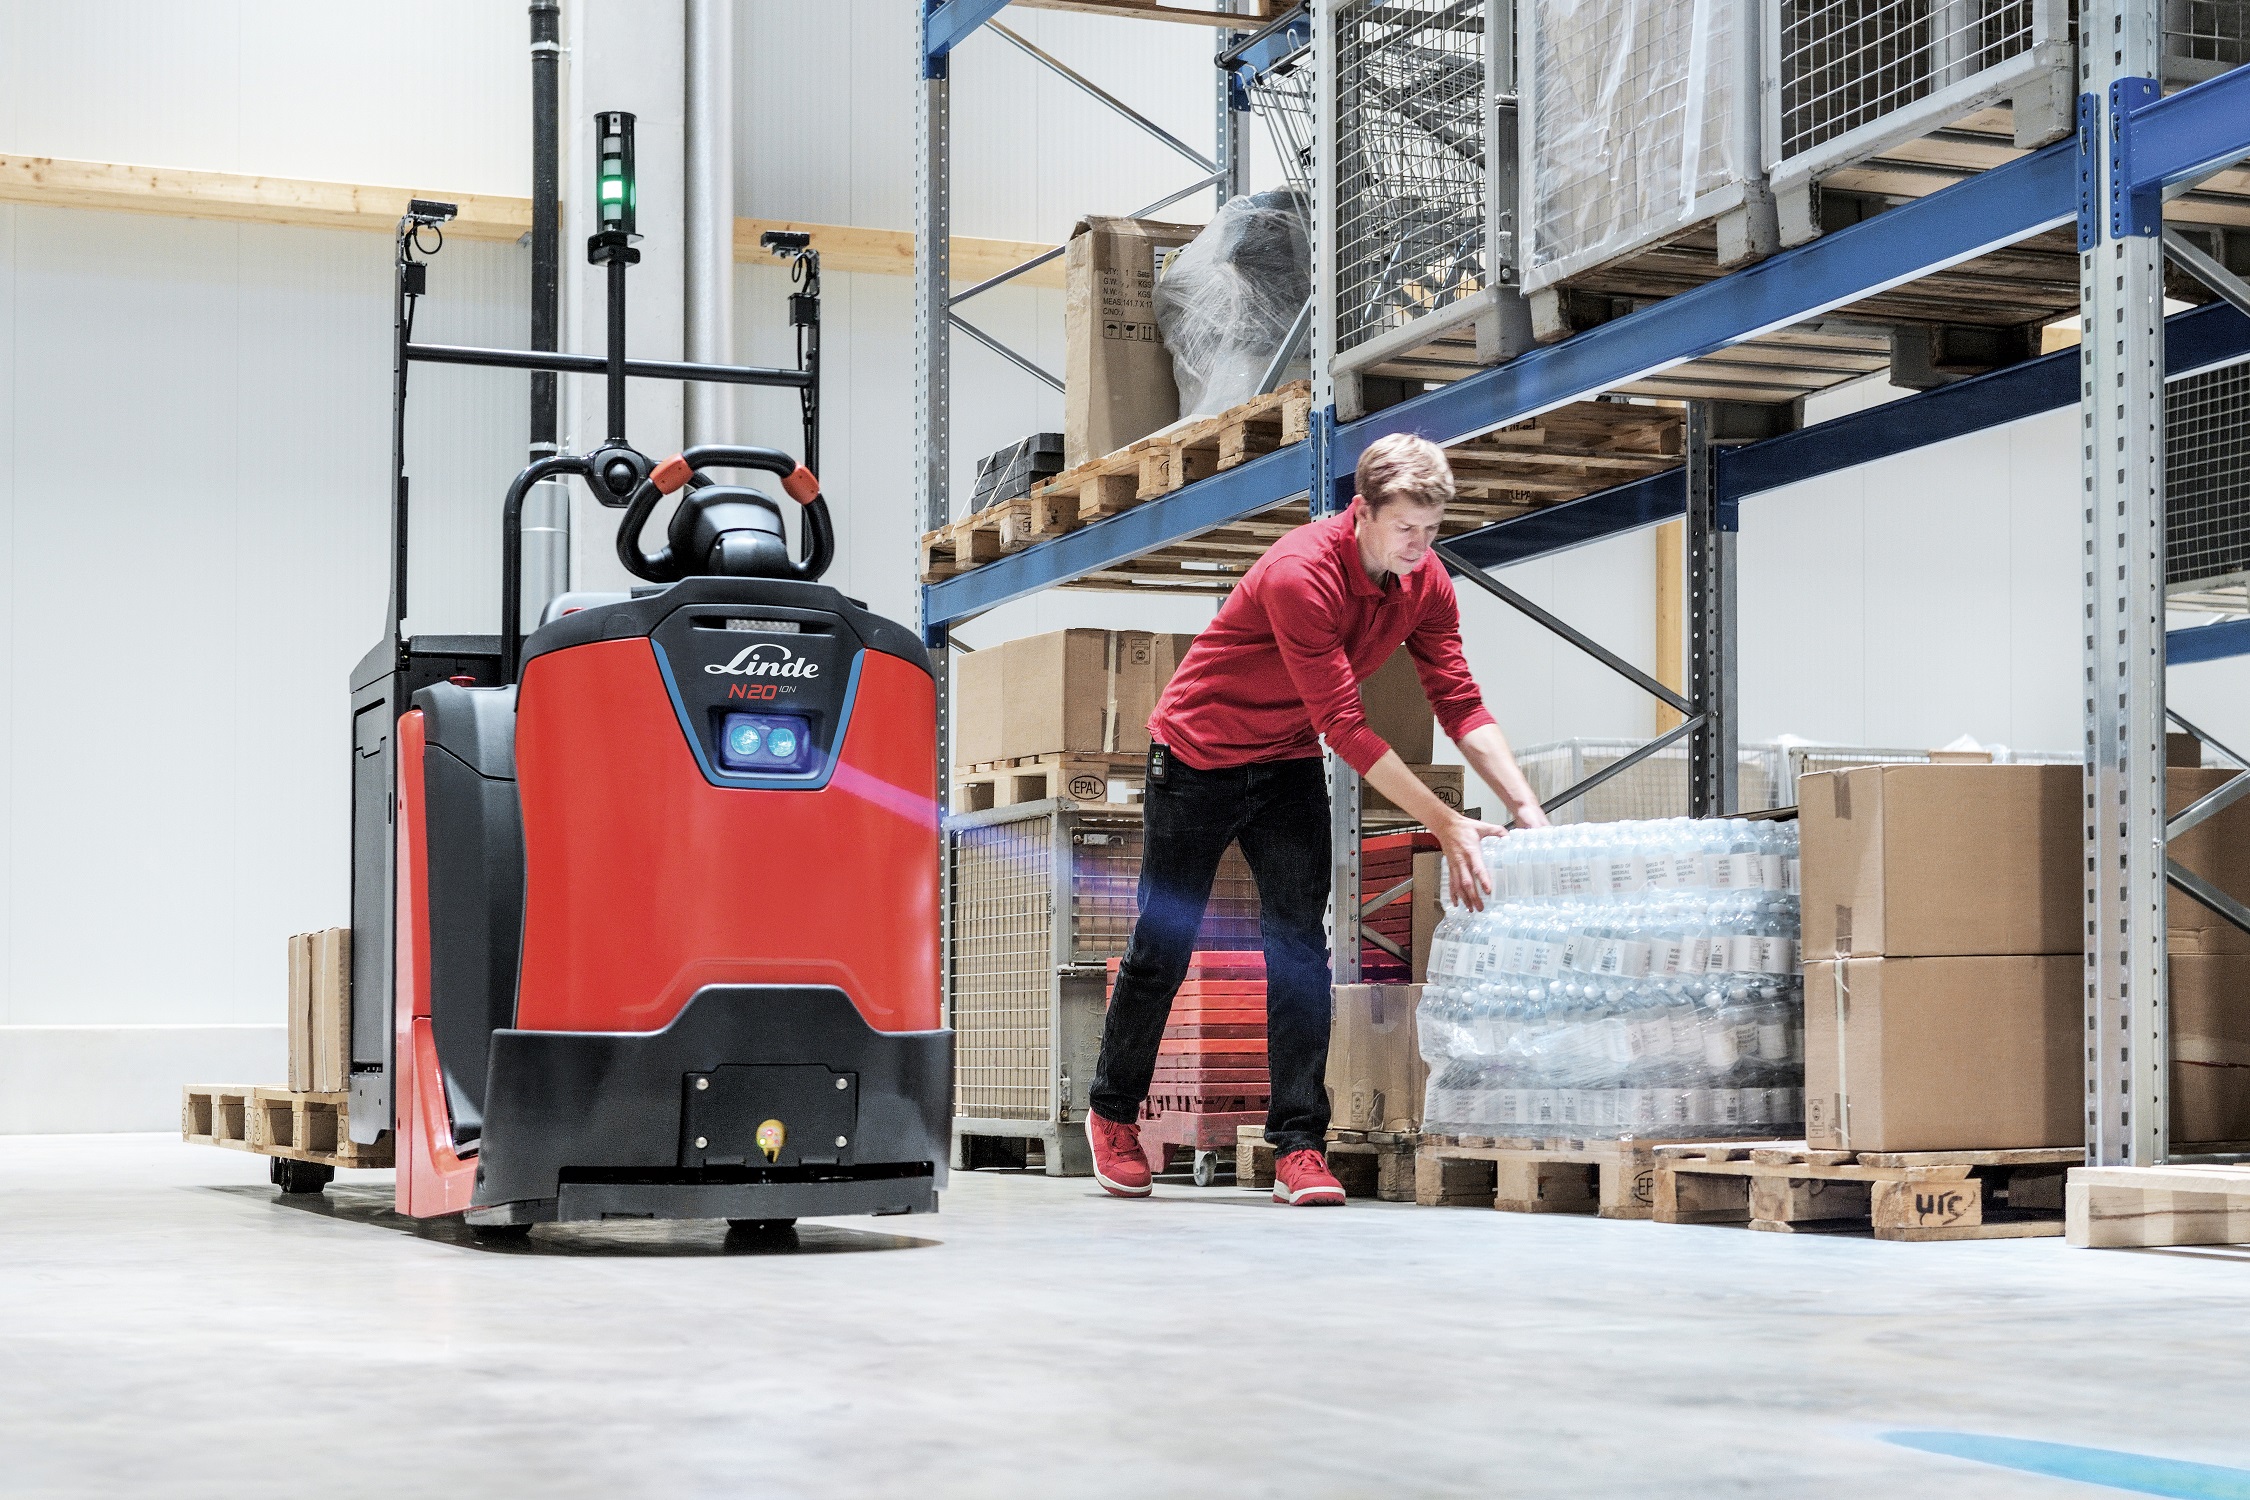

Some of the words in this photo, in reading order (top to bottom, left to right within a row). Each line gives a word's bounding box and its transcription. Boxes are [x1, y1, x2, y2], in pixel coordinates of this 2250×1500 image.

[1138, 280, 1152, 288] KGS
[1137, 290, 1152, 299] KGS
[704, 643, 819, 678] Linde
[1074, 780, 1100, 795] EPAL
[1433, 791, 1457, 804] PAL
[1638, 1177, 1653, 1196] EP
